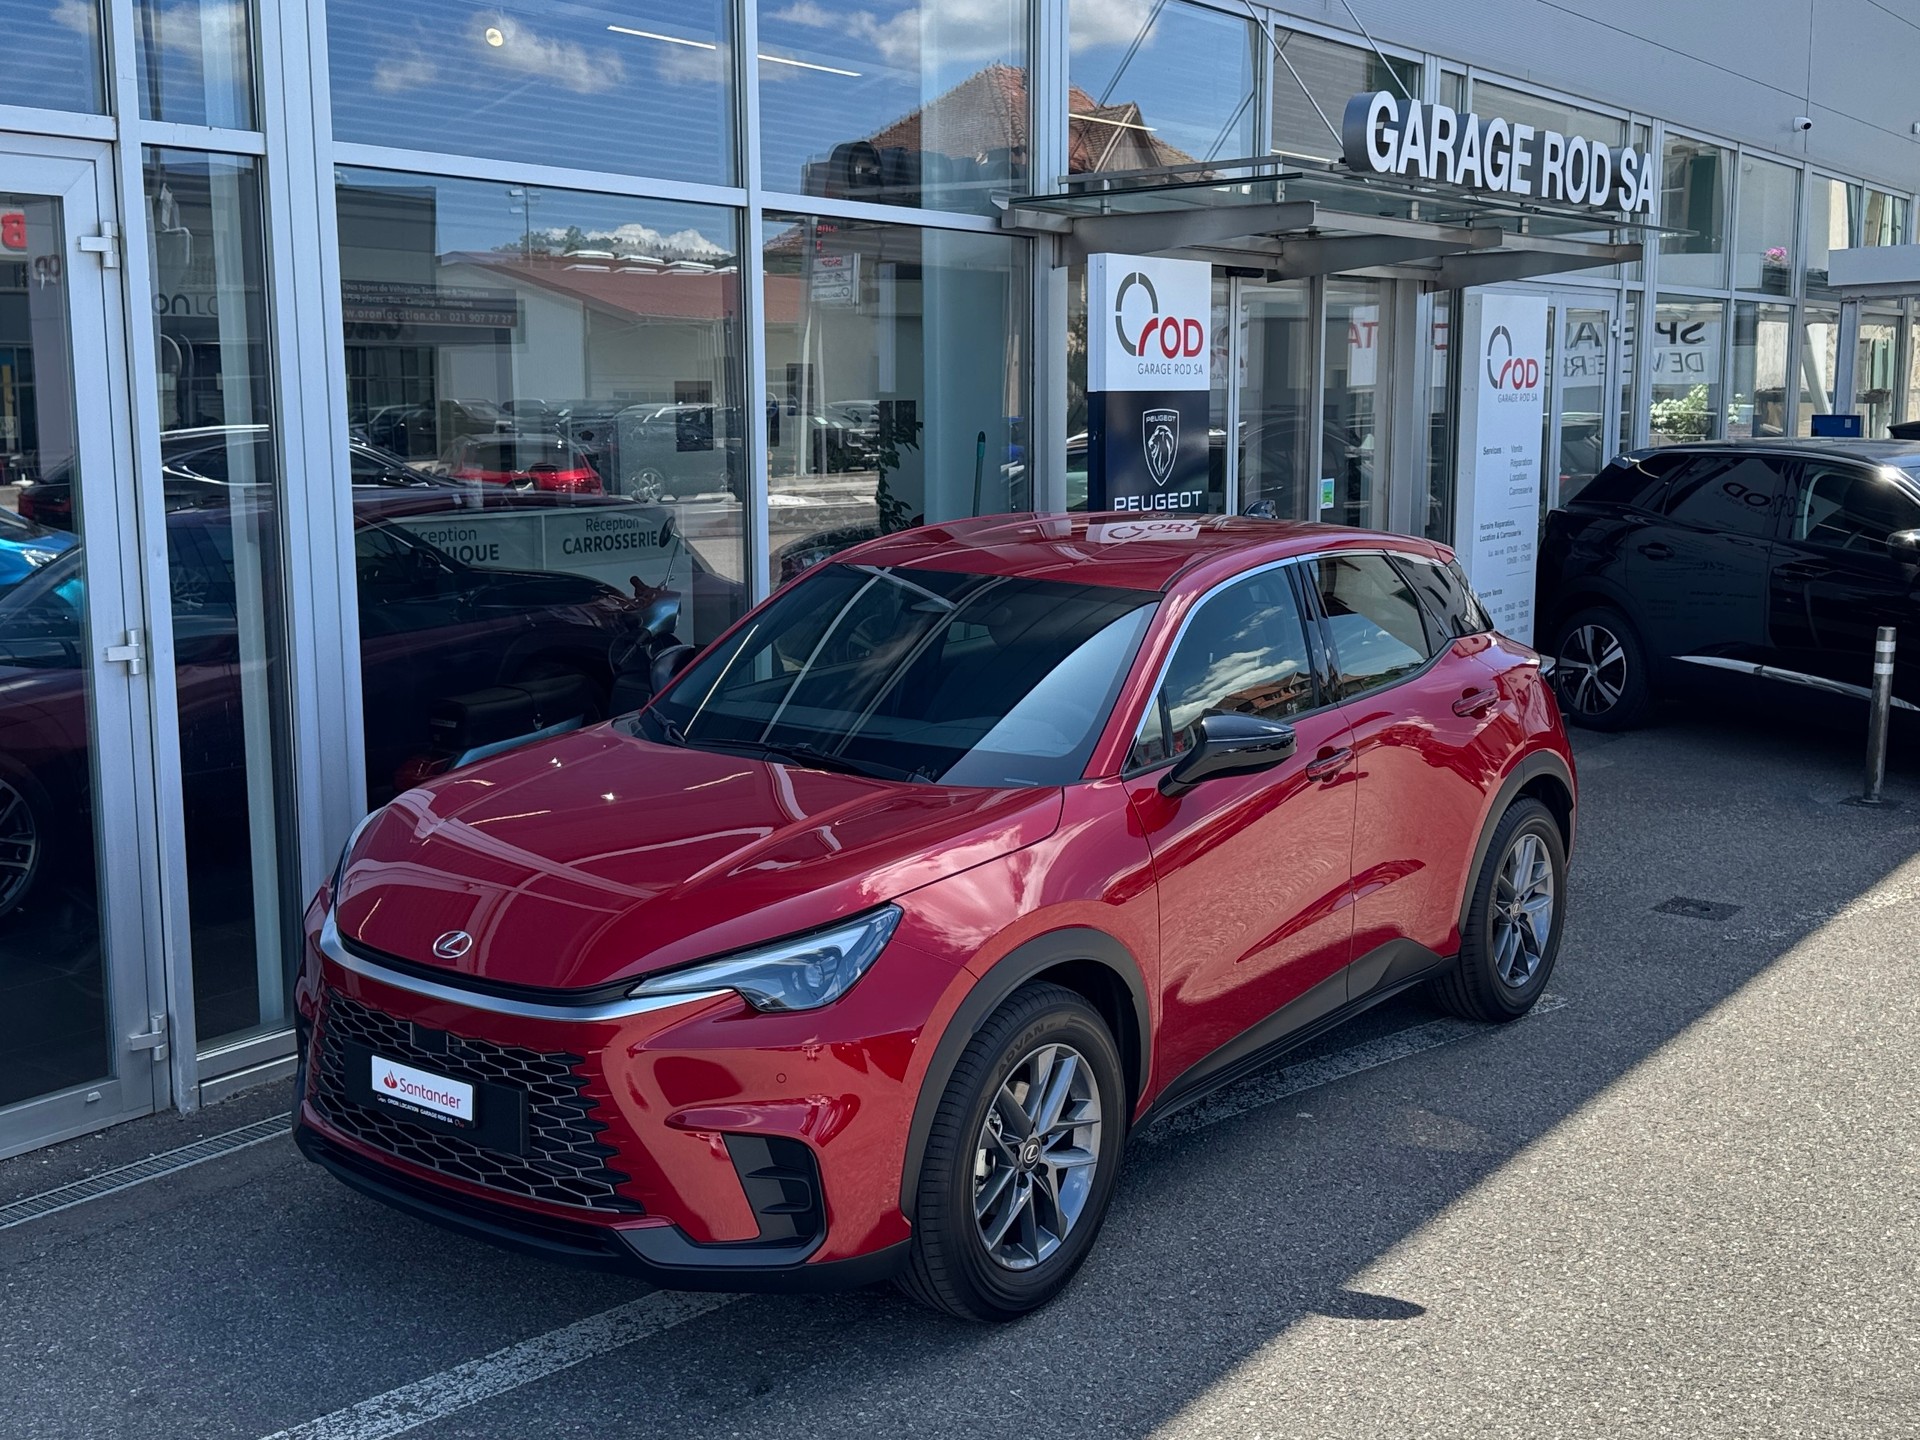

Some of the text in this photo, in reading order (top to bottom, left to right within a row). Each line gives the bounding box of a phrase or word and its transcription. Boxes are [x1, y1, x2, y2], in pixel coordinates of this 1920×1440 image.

[1360, 90, 1655, 215] GARAGE ROD SA
[450, 312, 466, 323] 021
[469, 313, 485, 324] 907
[1137, 362, 1204, 375] GARAGE ROD SA
[1498, 392, 1519, 403] GARAGE
[1519, 393, 1530, 402] ROD
[1145, 414, 1177, 423] PEUGEOT
[1509, 473, 1527, 482] Location
[1114, 491, 1203, 512] PEUGEOT
[585, 517, 639, 533] Réception
[562, 530, 659, 555] CARROSSERIE
[997, 1022, 1044, 1079] ADVAN
[399, 1077, 462, 1111] Santander
